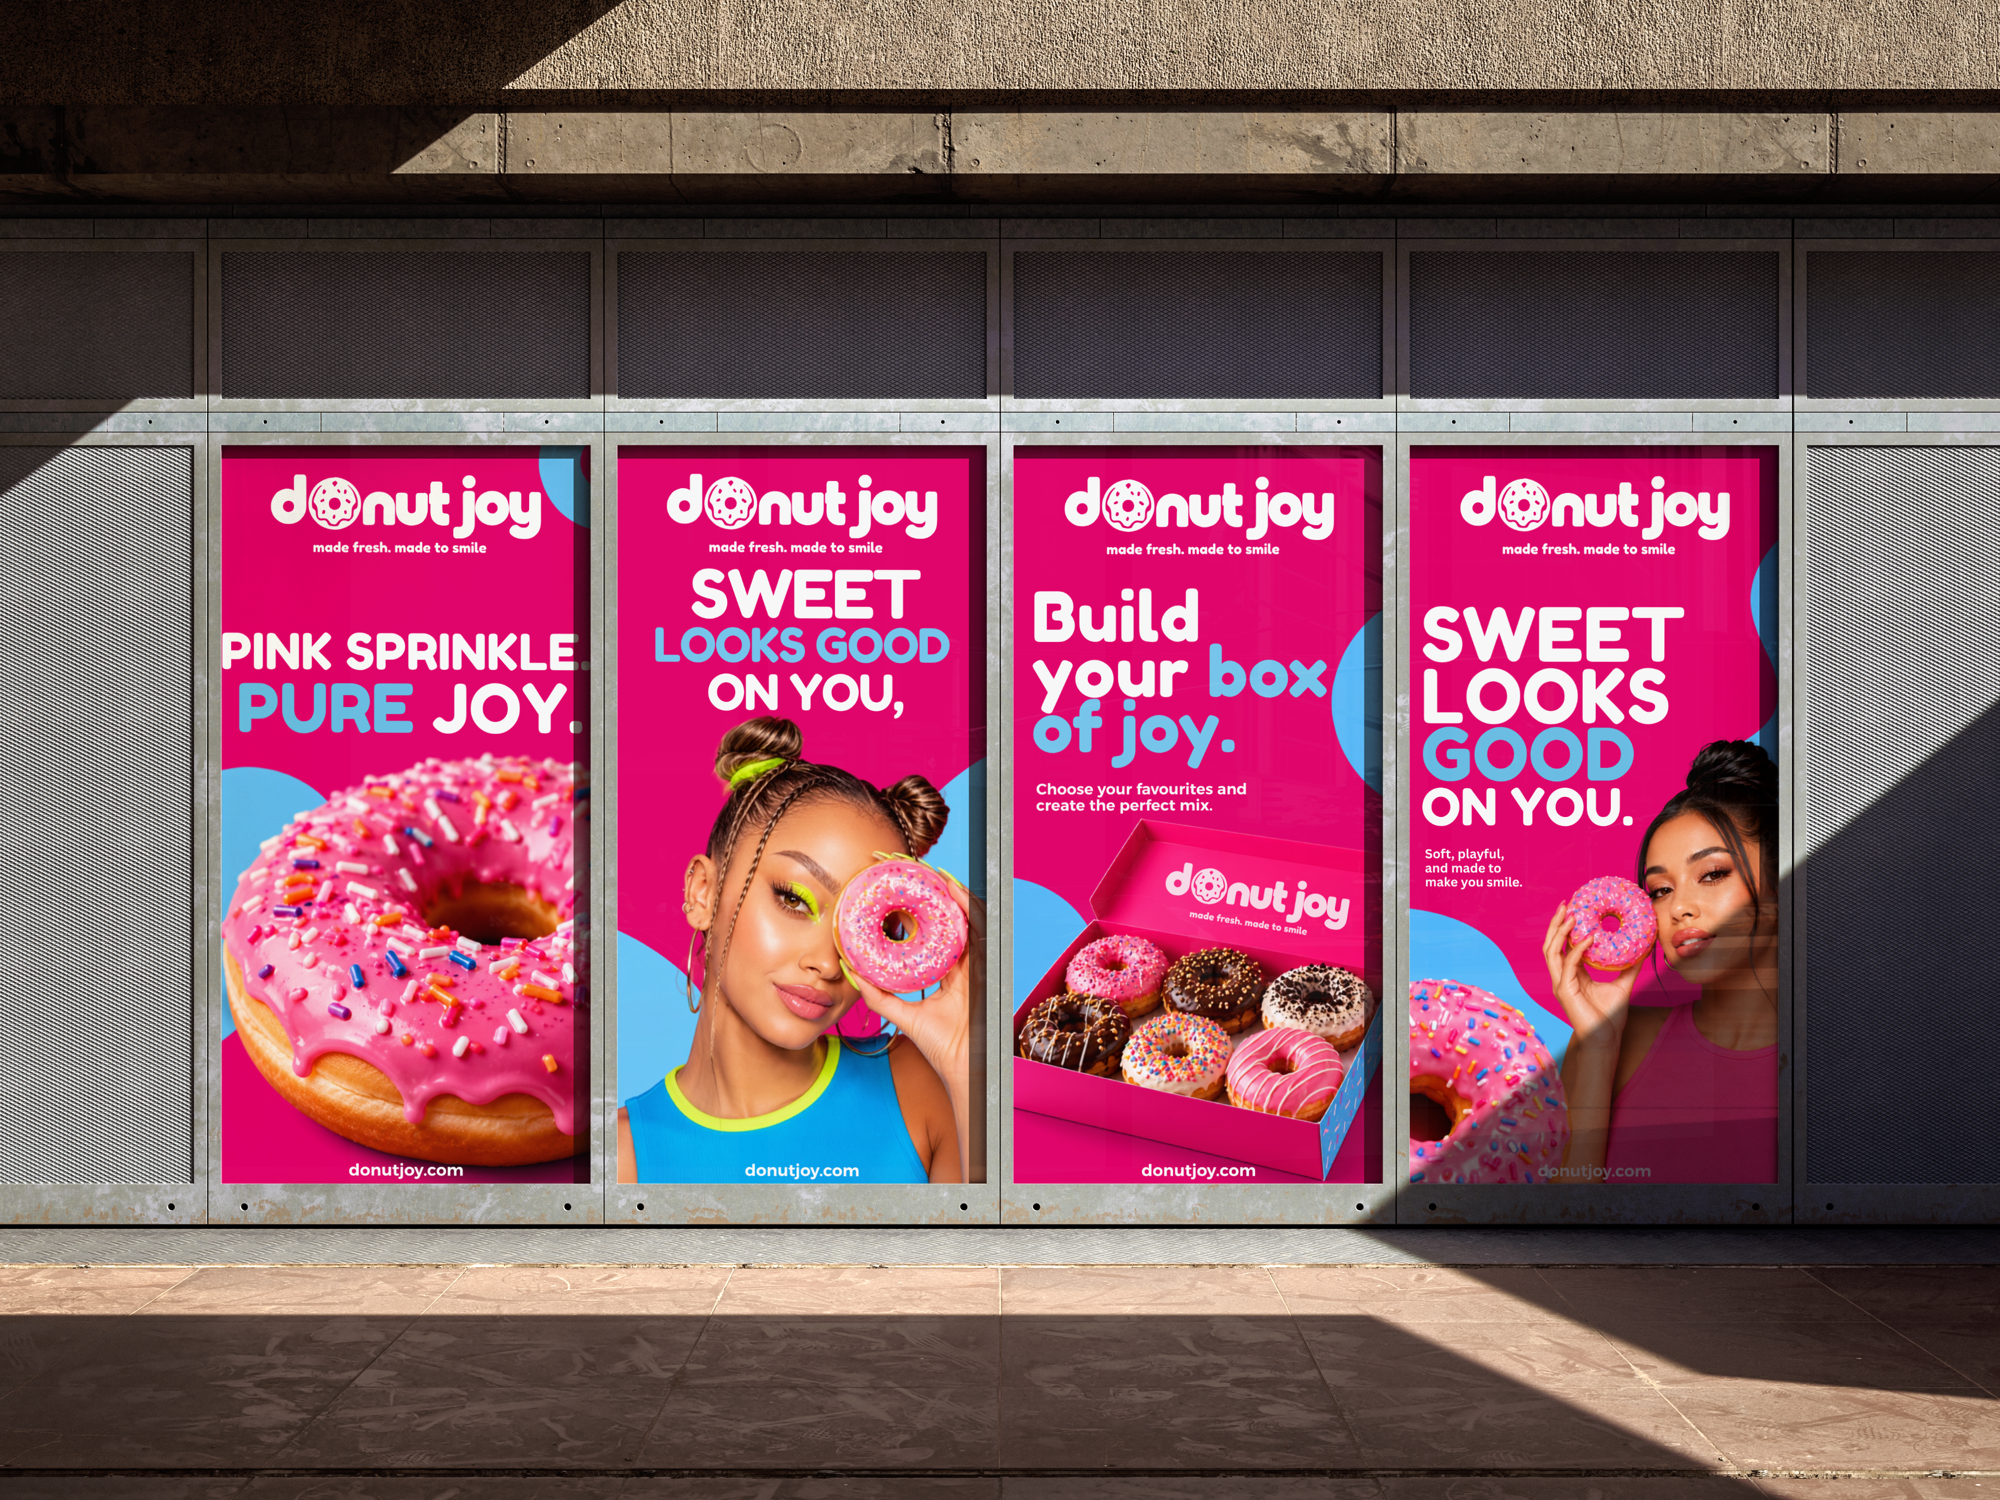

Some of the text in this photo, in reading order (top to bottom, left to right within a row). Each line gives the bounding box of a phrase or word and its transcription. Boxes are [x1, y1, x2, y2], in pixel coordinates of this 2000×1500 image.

[271, 474, 542, 539] donut joy
[667, 474, 938, 539] donut joy
[1064, 477, 1334, 540] donut joy
[1460, 476, 1730, 540] donut joy
[313, 542, 487, 554] made fresh. made to smile
[709, 542, 883, 553] made fresh. made to smile
[1107, 544, 1280, 555] made fresh. made to smile
[1502, 543, 1675, 555] made fresh. made to smile
[691, 568, 921, 619] SWEET
[1034, 588, 1198, 642] Build
[1423, 606, 1685, 662] SWEET
[222, 632, 590, 671] PINK SPRINKLE.
[655, 627, 950, 663] LOOKS GOOD
[708, 673, 904, 718] ON YOU,
[1032, 644, 1327, 714] your box
[1423, 668, 1669, 725] LOOKS
[239, 683, 583, 734] PURE JOY.
[1033, 699, 1235, 769] of joy.
[1423, 726, 1634, 781] GOOD
[1036, 783, 1247, 798] Choose your favourites and
[1036, 799, 1212, 813] create the perfect mix.
[1422, 787, 1633, 826] ON YOU.
[1425, 849, 1504, 862] Soft, playful,
[1425, 863, 1501, 873] and made to
[1165, 862, 1350, 930] donut joy
[1425, 877, 1523, 889] make you smile.
[1189, 911, 1308, 935] made fresh. made to smile
[348, 1162, 464, 1179] donutjoy.com
[744, 1162, 859, 1179] donutjoy.com
[1142, 1164, 1256, 1180] donutjoy.com
[1538, 1164, 1651, 1180] donutjoy.com
